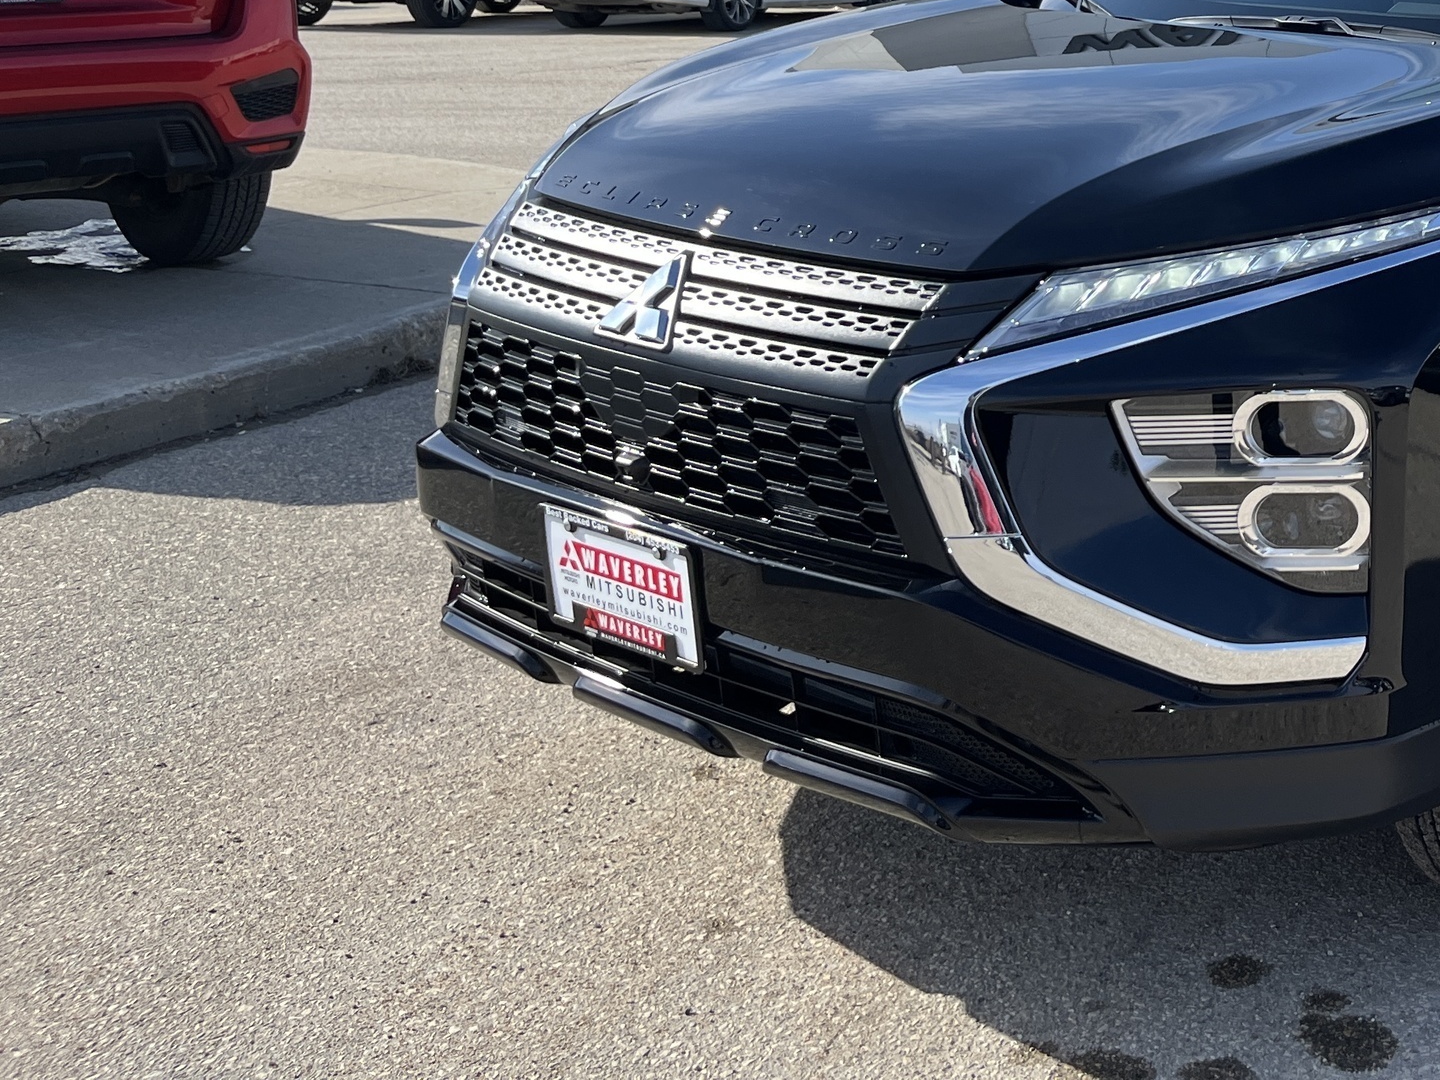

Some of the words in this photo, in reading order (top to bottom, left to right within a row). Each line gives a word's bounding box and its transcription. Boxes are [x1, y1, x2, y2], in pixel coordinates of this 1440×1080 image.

[754, 217, 949, 257] CROSS
[545, 505, 562, 519] Best
[564, 510, 590, 526] Backed
[591, 520, 609, 533] Cars
[580, 546, 682, 598] WAVERLEY
[563, 586, 688, 635] waverleymitsubishi.com
[586, 574, 684, 619] MITSUBISHI
[598, 612, 663, 648] WAVERLEY
